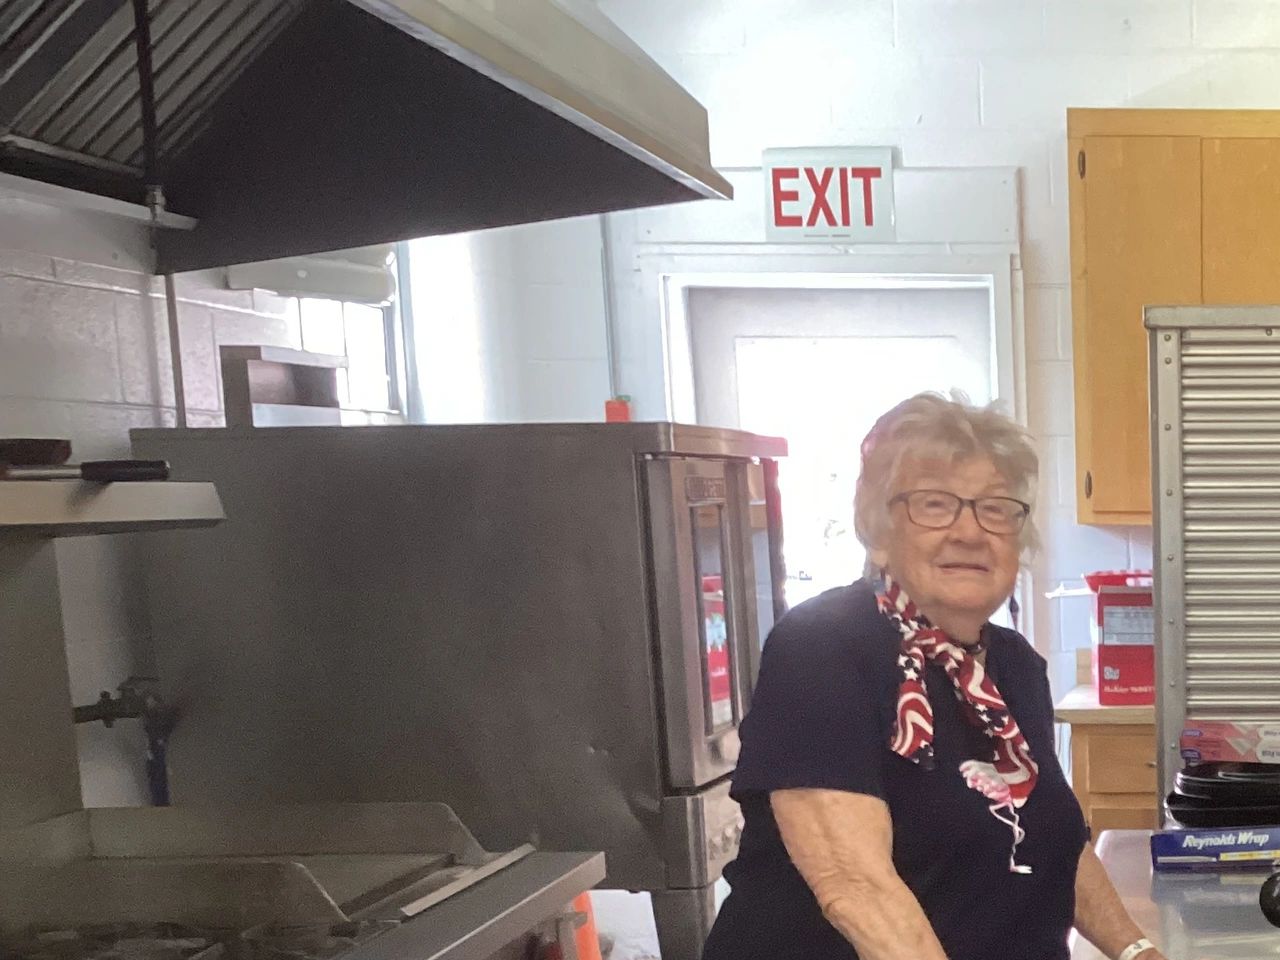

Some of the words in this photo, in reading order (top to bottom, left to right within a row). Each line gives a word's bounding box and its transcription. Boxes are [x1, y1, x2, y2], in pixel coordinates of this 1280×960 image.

[771, 167, 882, 227] EXIT
[1182, 833, 1236, 850] Reynolds
[1237, 832, 1270, 846] Wrap
